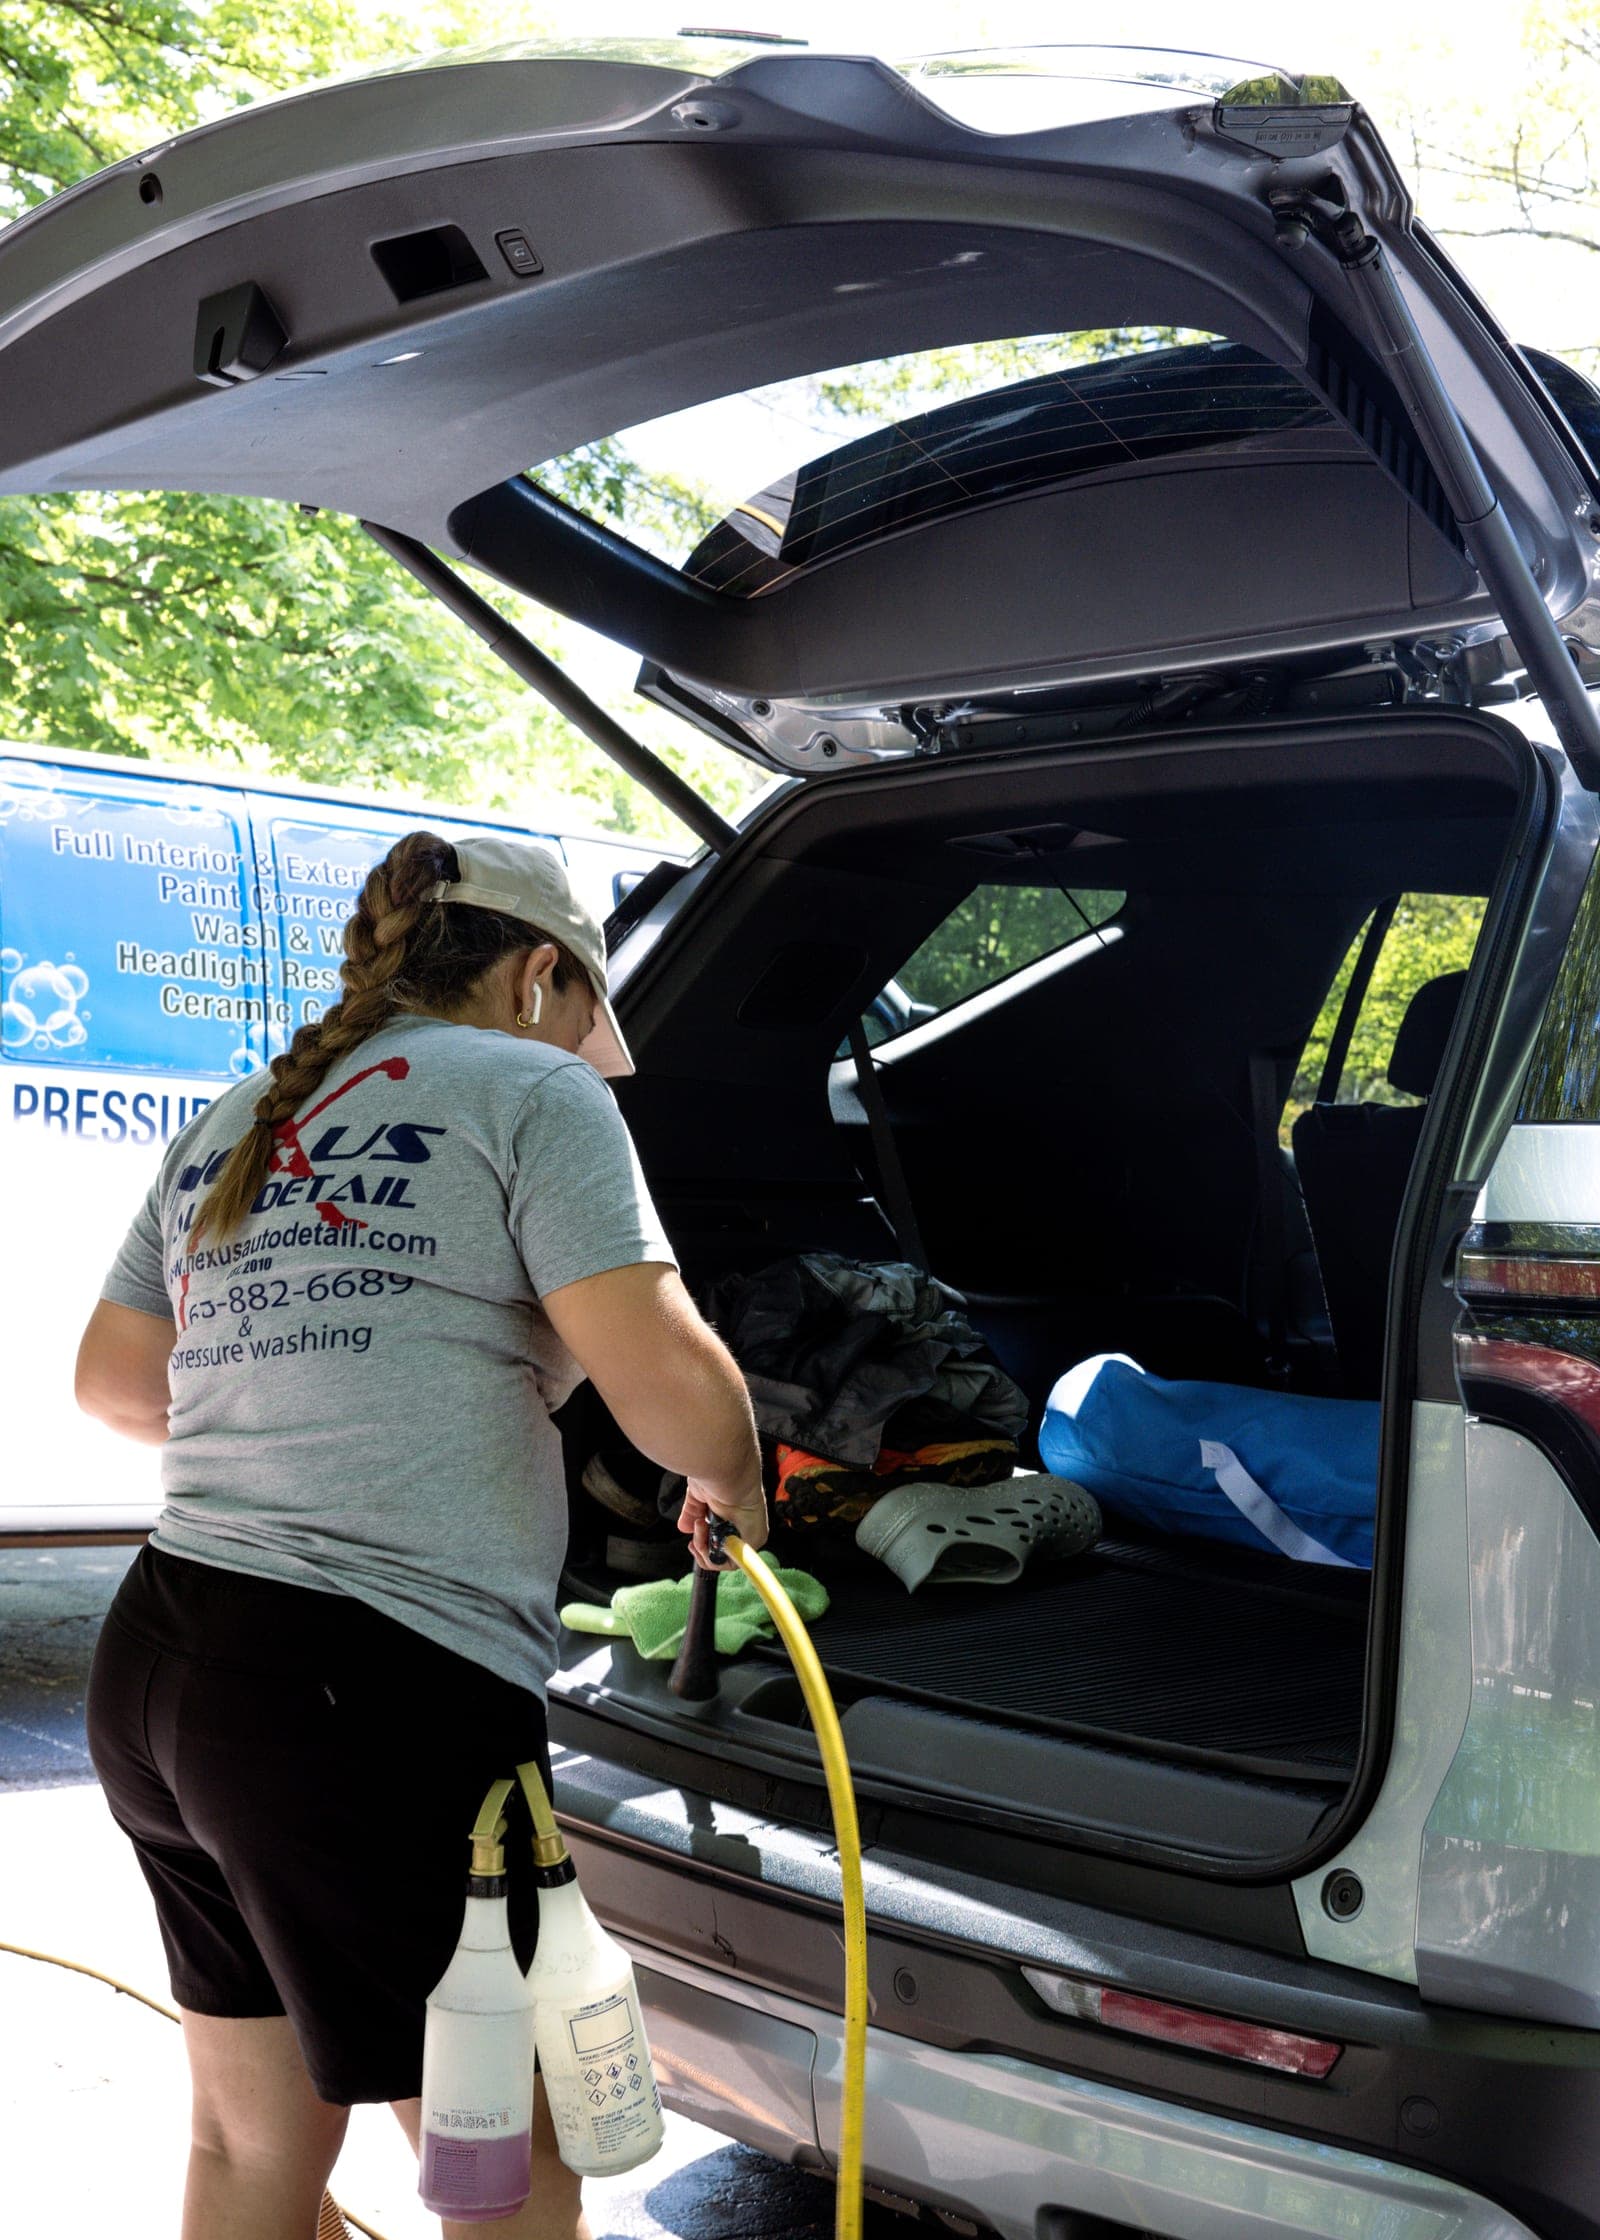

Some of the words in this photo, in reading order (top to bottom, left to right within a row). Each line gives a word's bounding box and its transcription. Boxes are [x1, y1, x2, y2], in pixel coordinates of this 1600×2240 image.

[54, 828, 112, 858] Full
[126, 836, 242, 874] Interior
[254, 852, 273, 877] &
[161, 876, 241, 909] Paint
[194, 915, 277, 948] Wash
[289, 925, 310, 951] &
[118, 943, 272, 987] Headlight
[161, 987, 290, 1024] Ceramic
[250, 1174, 416, 1214] DETAIL
[242, 1257, 272, 1274] 2010
[238, 1315, 252, 1338] &
[249, 1325, 372, 1360] washing
